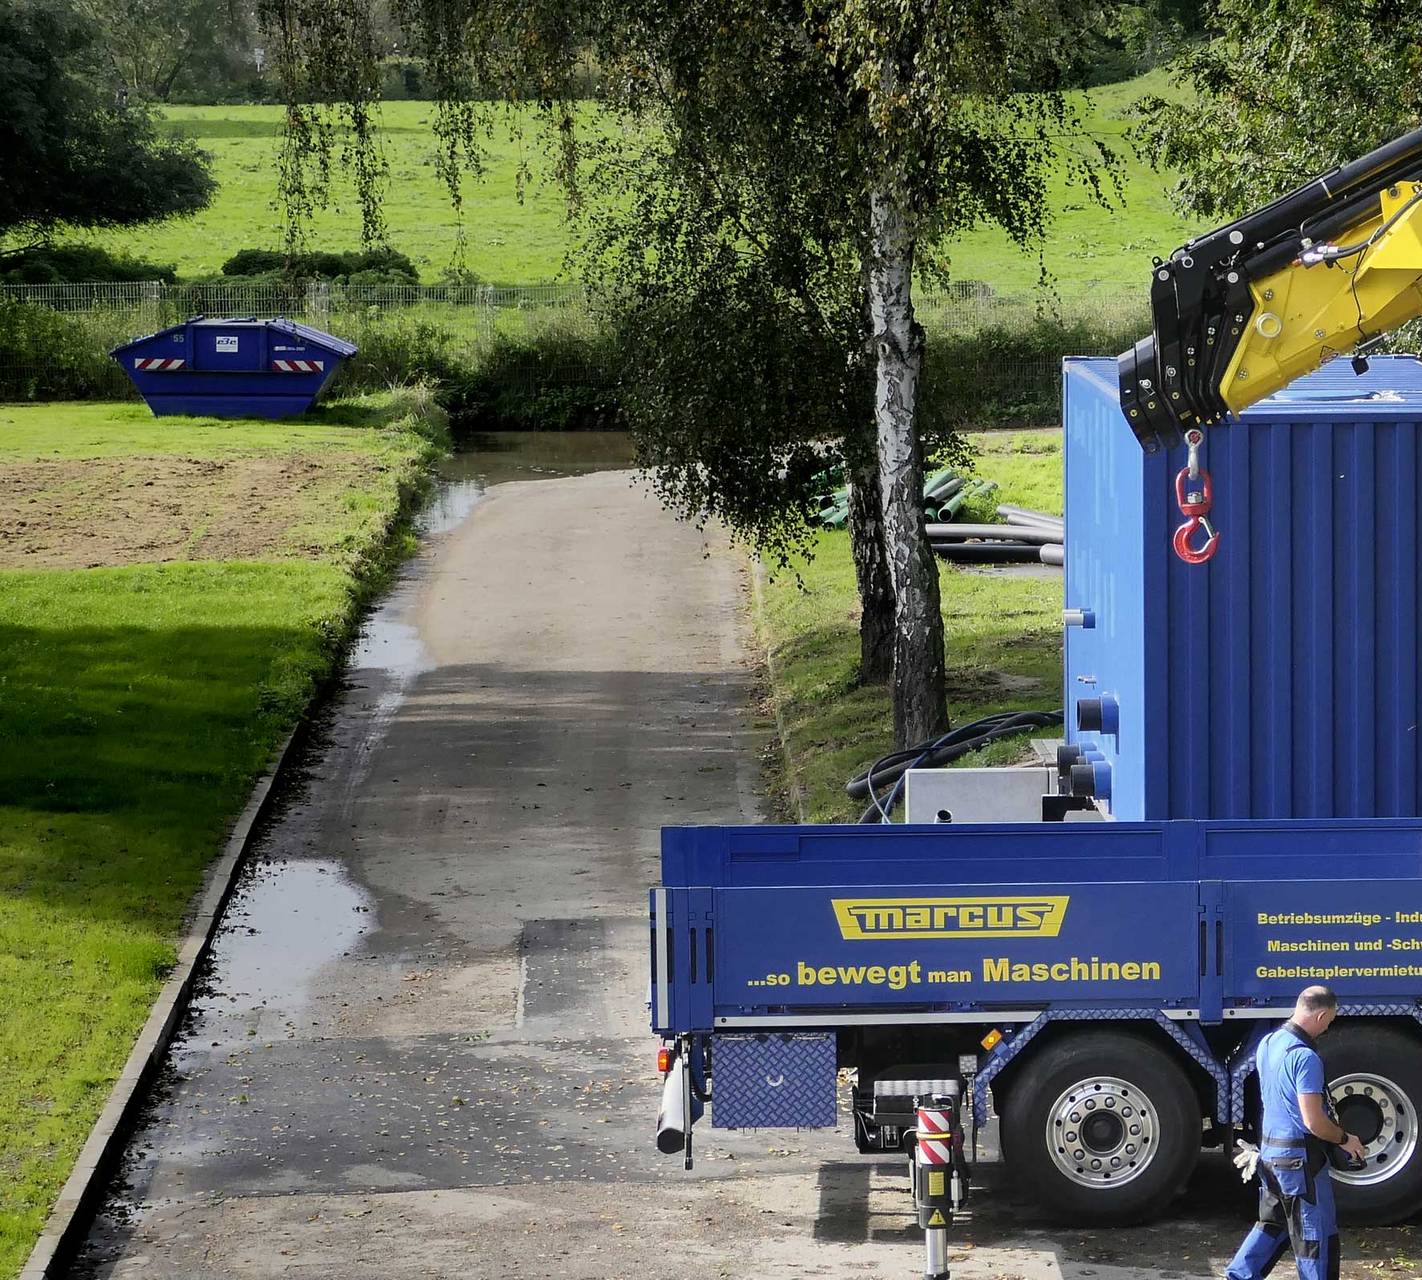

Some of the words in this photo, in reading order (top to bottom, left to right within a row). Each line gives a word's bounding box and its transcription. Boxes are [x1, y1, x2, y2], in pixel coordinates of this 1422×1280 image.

[849, 903, 1054, 930] marcus
[1257, 911, 1382, 926] Betriebsumzüge
[1267, 939, 1350, 952] Maschinen
[1354, 939, 1383, 951] und
[797, 959, 922, 990] bewegt
[927, 970, 972, 983] man
[982, 956, 1161, 983] Maschinen
